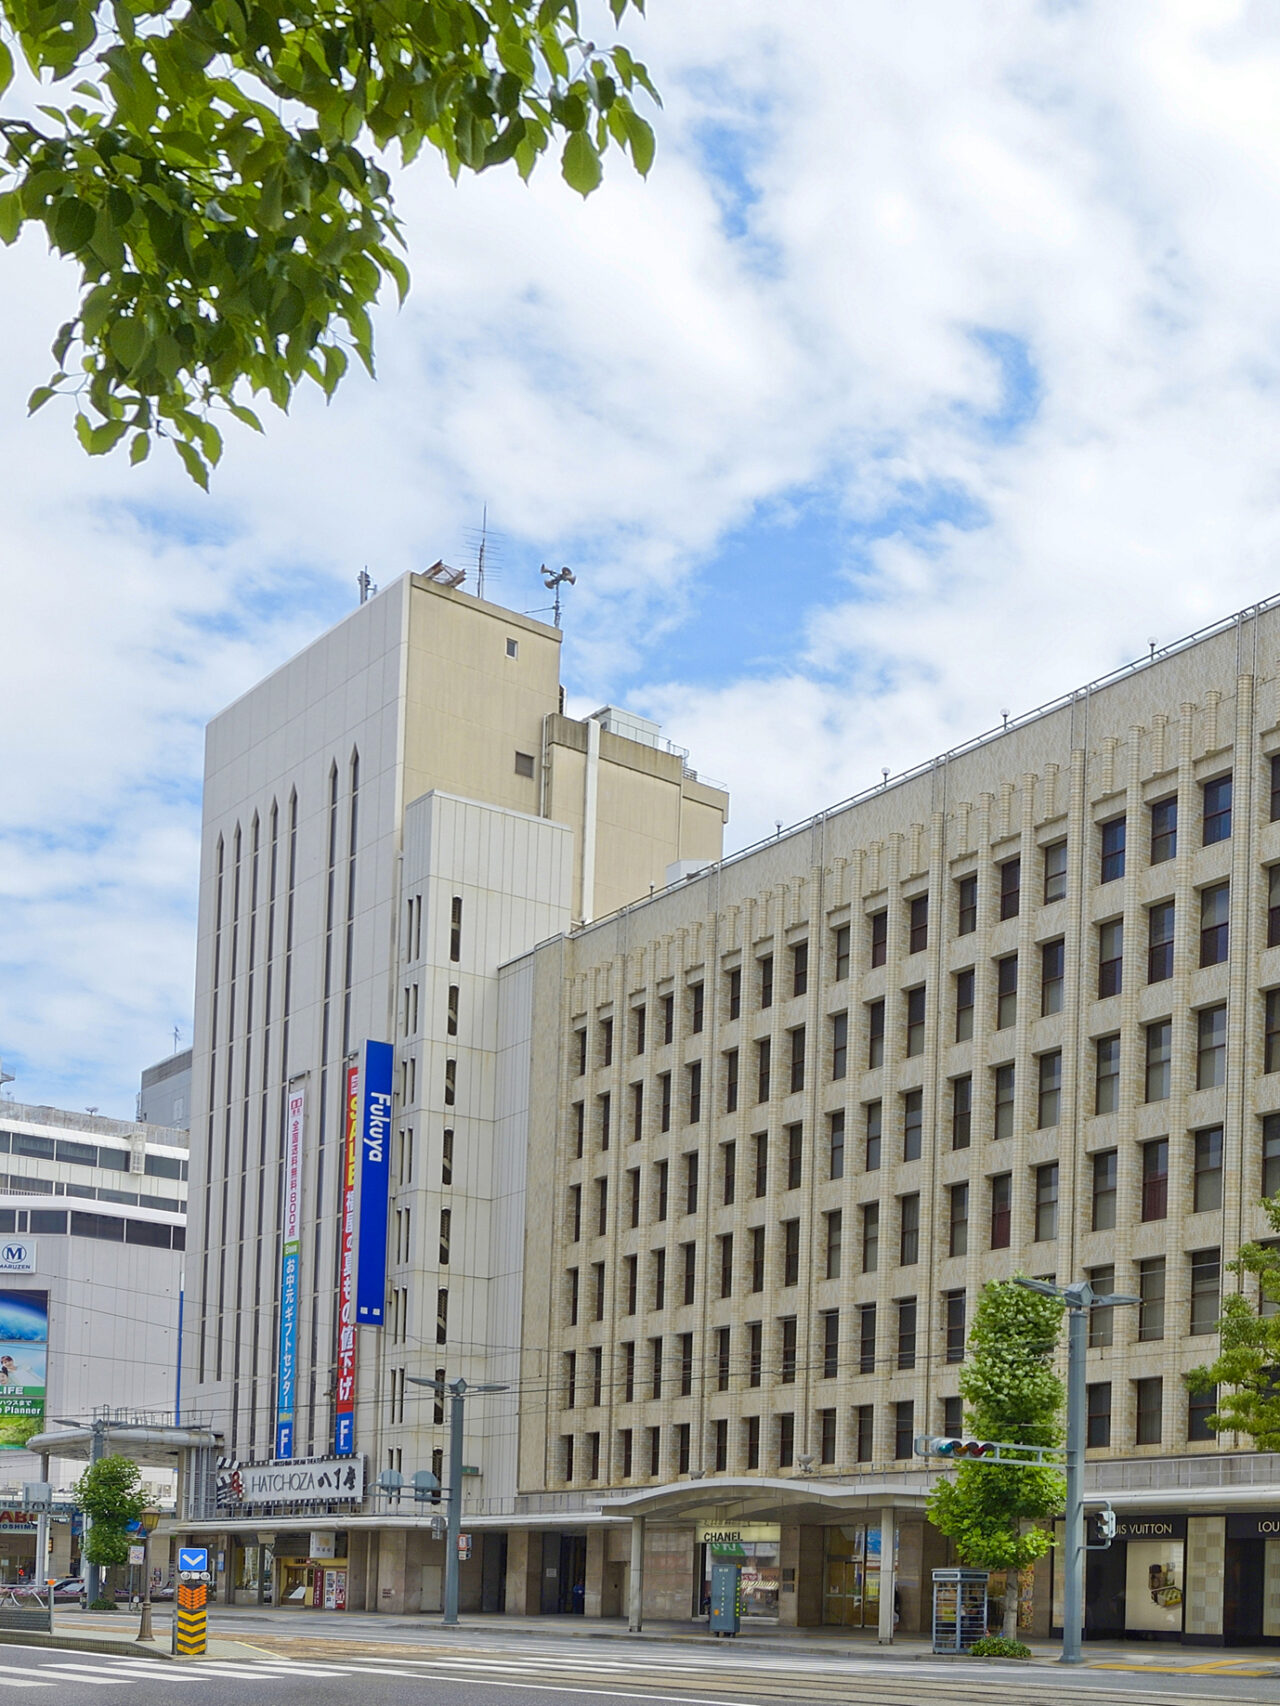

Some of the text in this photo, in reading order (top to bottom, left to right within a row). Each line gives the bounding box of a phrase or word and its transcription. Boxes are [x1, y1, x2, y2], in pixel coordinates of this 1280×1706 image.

[363, 1091, 391, 1163] Fukuya
[282, 1258, 295, 1411] お中元ギフトセンター
[5, 1406, 41, 1415] Planner
[280, 1428, 290, 1455] F
[340, 1419, 350, 1447] F
[252, 1472, 315, 1492] HATCHOZA
[704, 1531, 743, 1542] CHANEL
[1129, 1524, 1173, 1535] VUITTON
